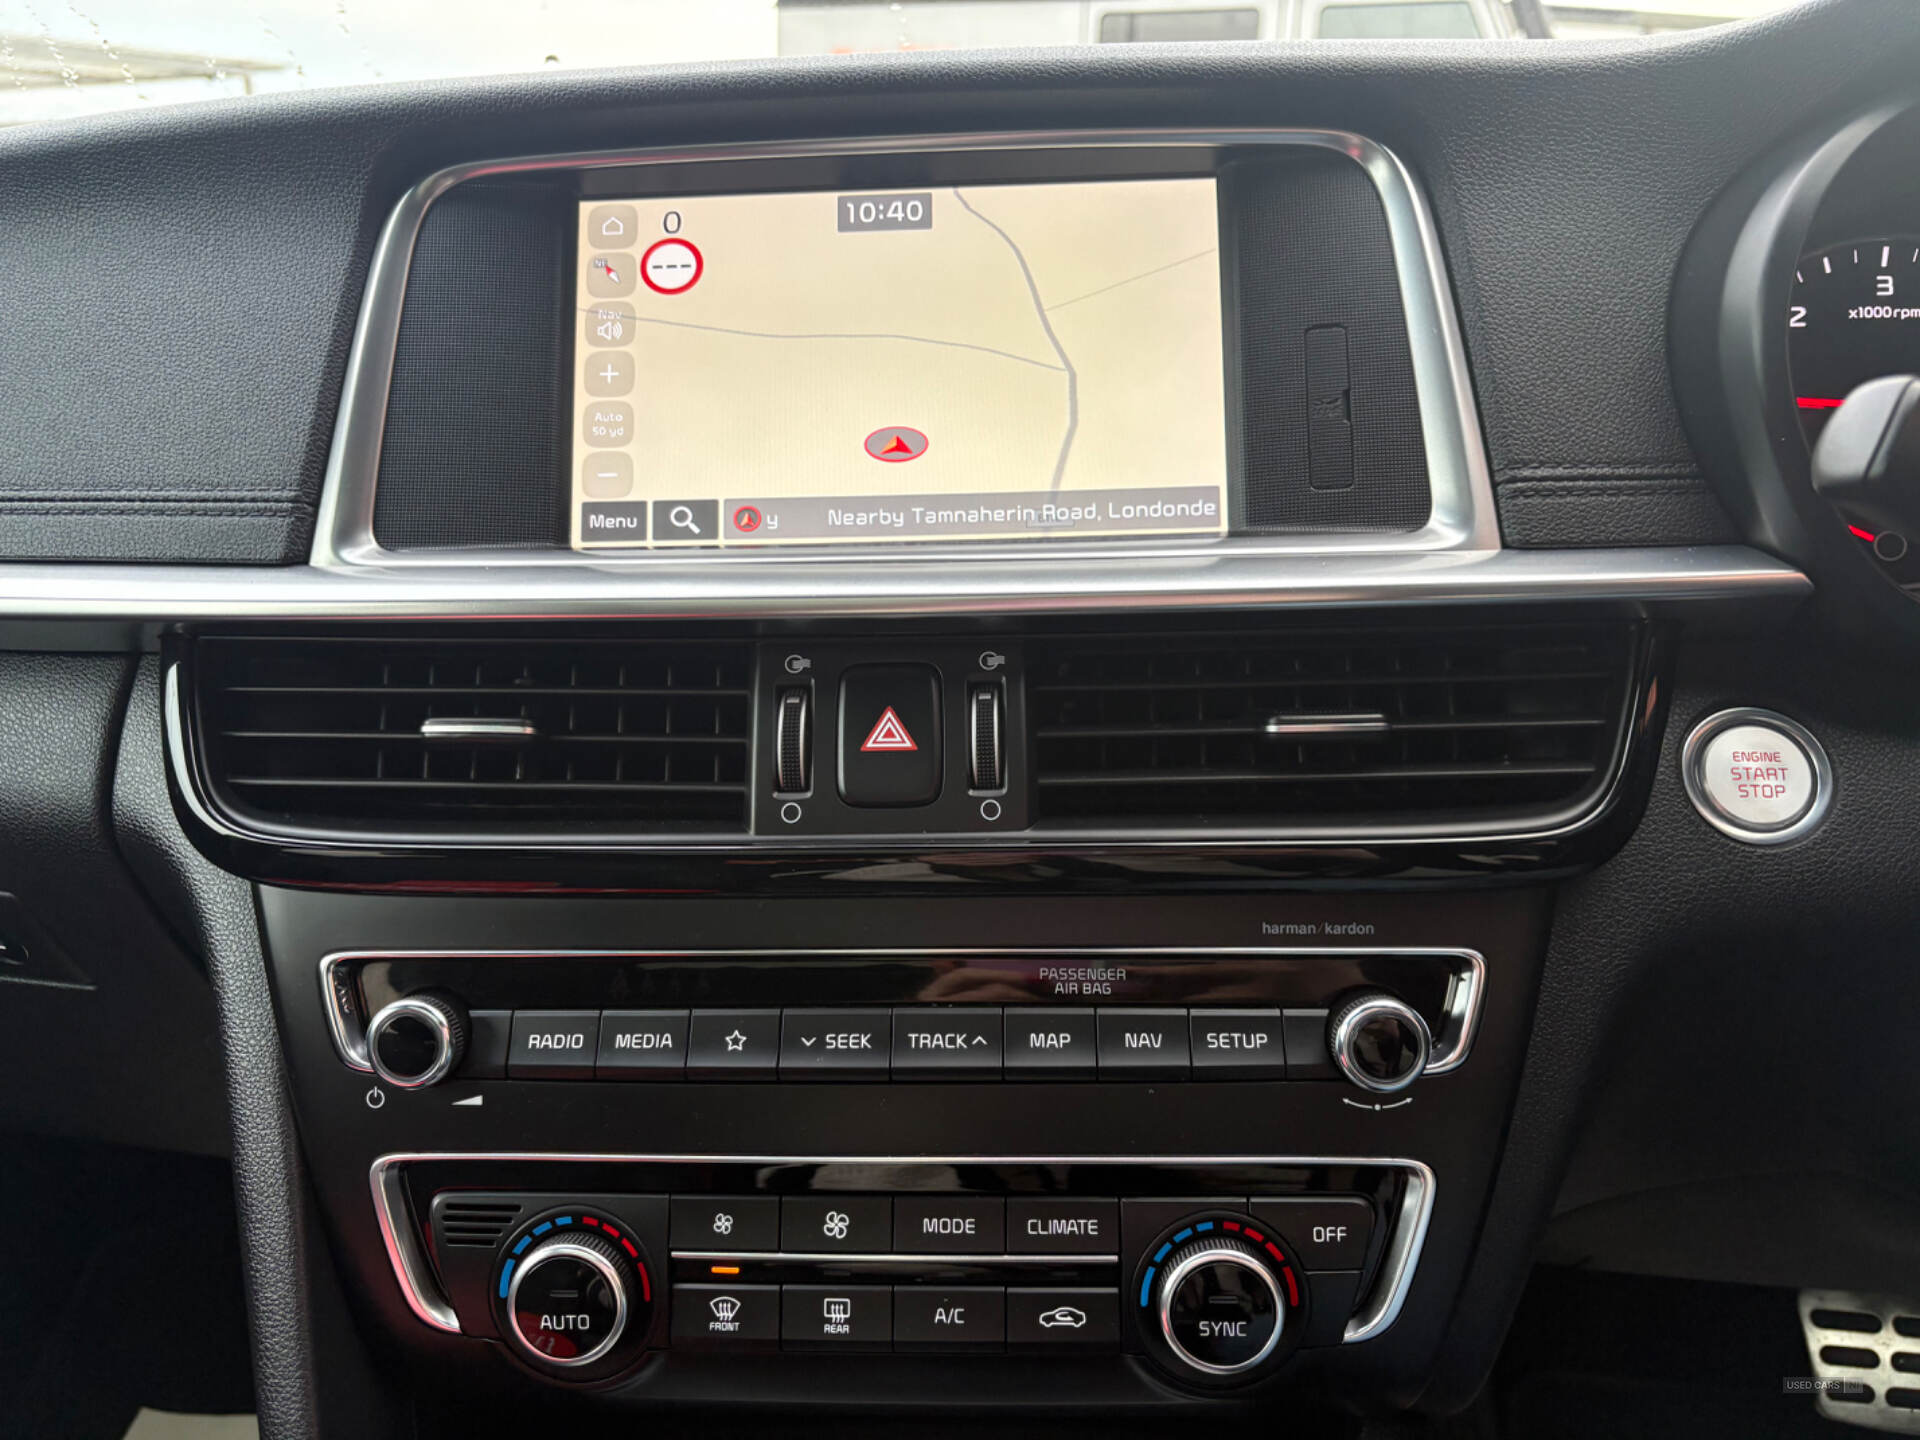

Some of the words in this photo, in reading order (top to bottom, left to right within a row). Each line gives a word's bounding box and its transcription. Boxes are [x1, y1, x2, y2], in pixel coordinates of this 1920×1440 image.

[846, 200, 923, 224] 10:40
[662, 211, 682, 234] 0
[1876, 275, 1894, 296] 3
[598, 309, 622, 320] Nav
[1789, 306, 1807, 327] 2
[594, 412, 624, 423] Auto
[592, 426, 608, 437] 50
[610, 426, 624, 438] yd
[589, 513, 638, 529] Menu
[767, 514, 779, 529] y
[828, 508, 905, 528] Nearby
[911, 503, 1036, 524] Tamnaherin
[1042, 503, 1103, 522] Road,
[1108, 499, 1217, 519] Londonde
[1732, 751, 1782, 763] ENGINE
[1730, 767, 1789, 781] START
[1738, 784, 1786, 799] STOP
[1039, 967, 1127, 982] PASSENGER
[1054, 982, 1078, 995] AIR
[1081, 981, 1112, 995] BAG
[527, 1033, 584, 1049] RADIO
[614, 1033, 673, 1049] MEDIA
[825, 1033, 872, 1050] SEEK
[908, 1033, 968, 1049] TRACK
[1029, 1033, 1071, 1049] MAP
[1124, 1032, 1163, 1048] NAV
[1206, 1032, 1268, 1049] SETUP
[922, 1218, 976, 1234] MODE
[1027, 1218, 1099, 1235] CLIMATE
[1312, 1226, 1347, 1242] OFF
[540, 1314, 590, 1331] AUTO
[934, 1307, 965, 1325] A/C
[709, 1321, 740, 1332] FRONT
[824, 1324, 850, 1334] REAR
[1198, 1320, 1248, 1337] SYNC
